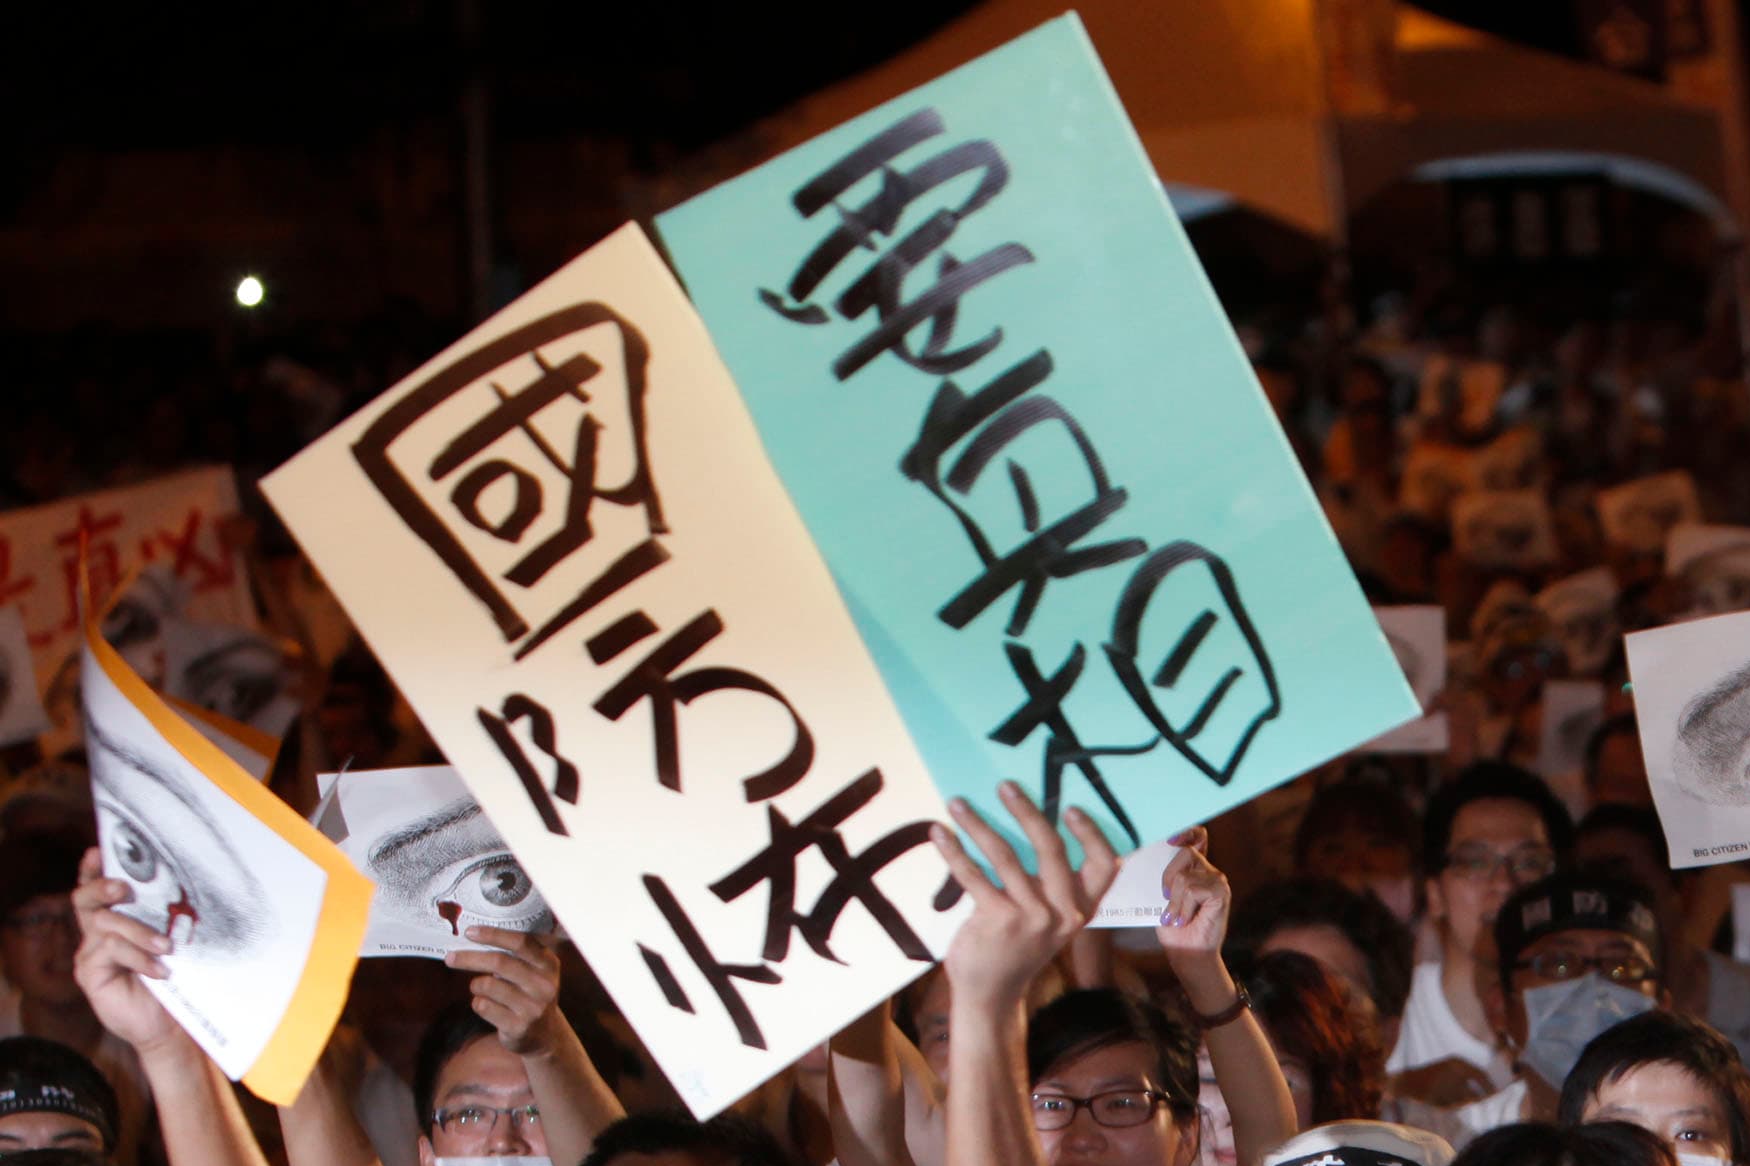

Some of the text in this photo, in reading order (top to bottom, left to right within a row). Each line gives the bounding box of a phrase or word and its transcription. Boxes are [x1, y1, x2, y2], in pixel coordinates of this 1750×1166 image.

[757, 106, 1282, 848] 要真相
[1693, 848, 1709, 857] BIG
[1711, 844, 1748, 856] CITIZEN
